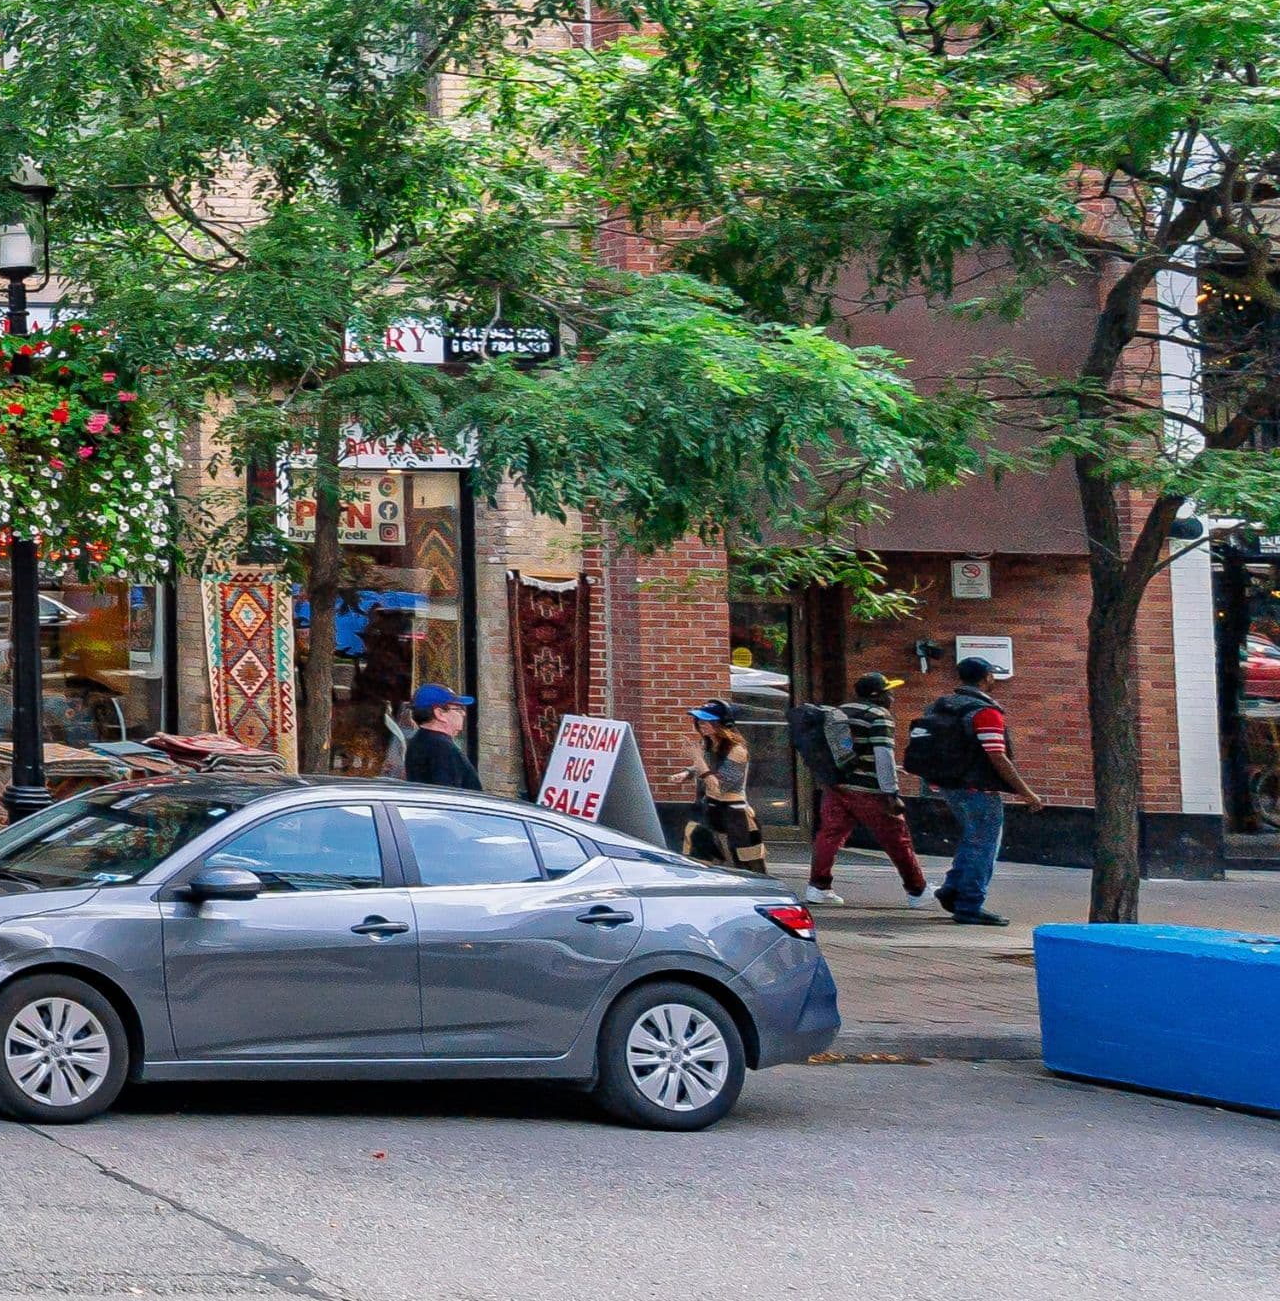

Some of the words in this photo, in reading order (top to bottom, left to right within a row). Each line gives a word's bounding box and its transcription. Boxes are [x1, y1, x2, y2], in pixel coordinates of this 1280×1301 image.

[559, 722, 621, 753] PERSIAN
[562, 756, 595, 783] RUG
[541, 786, 600, 818] SALE
